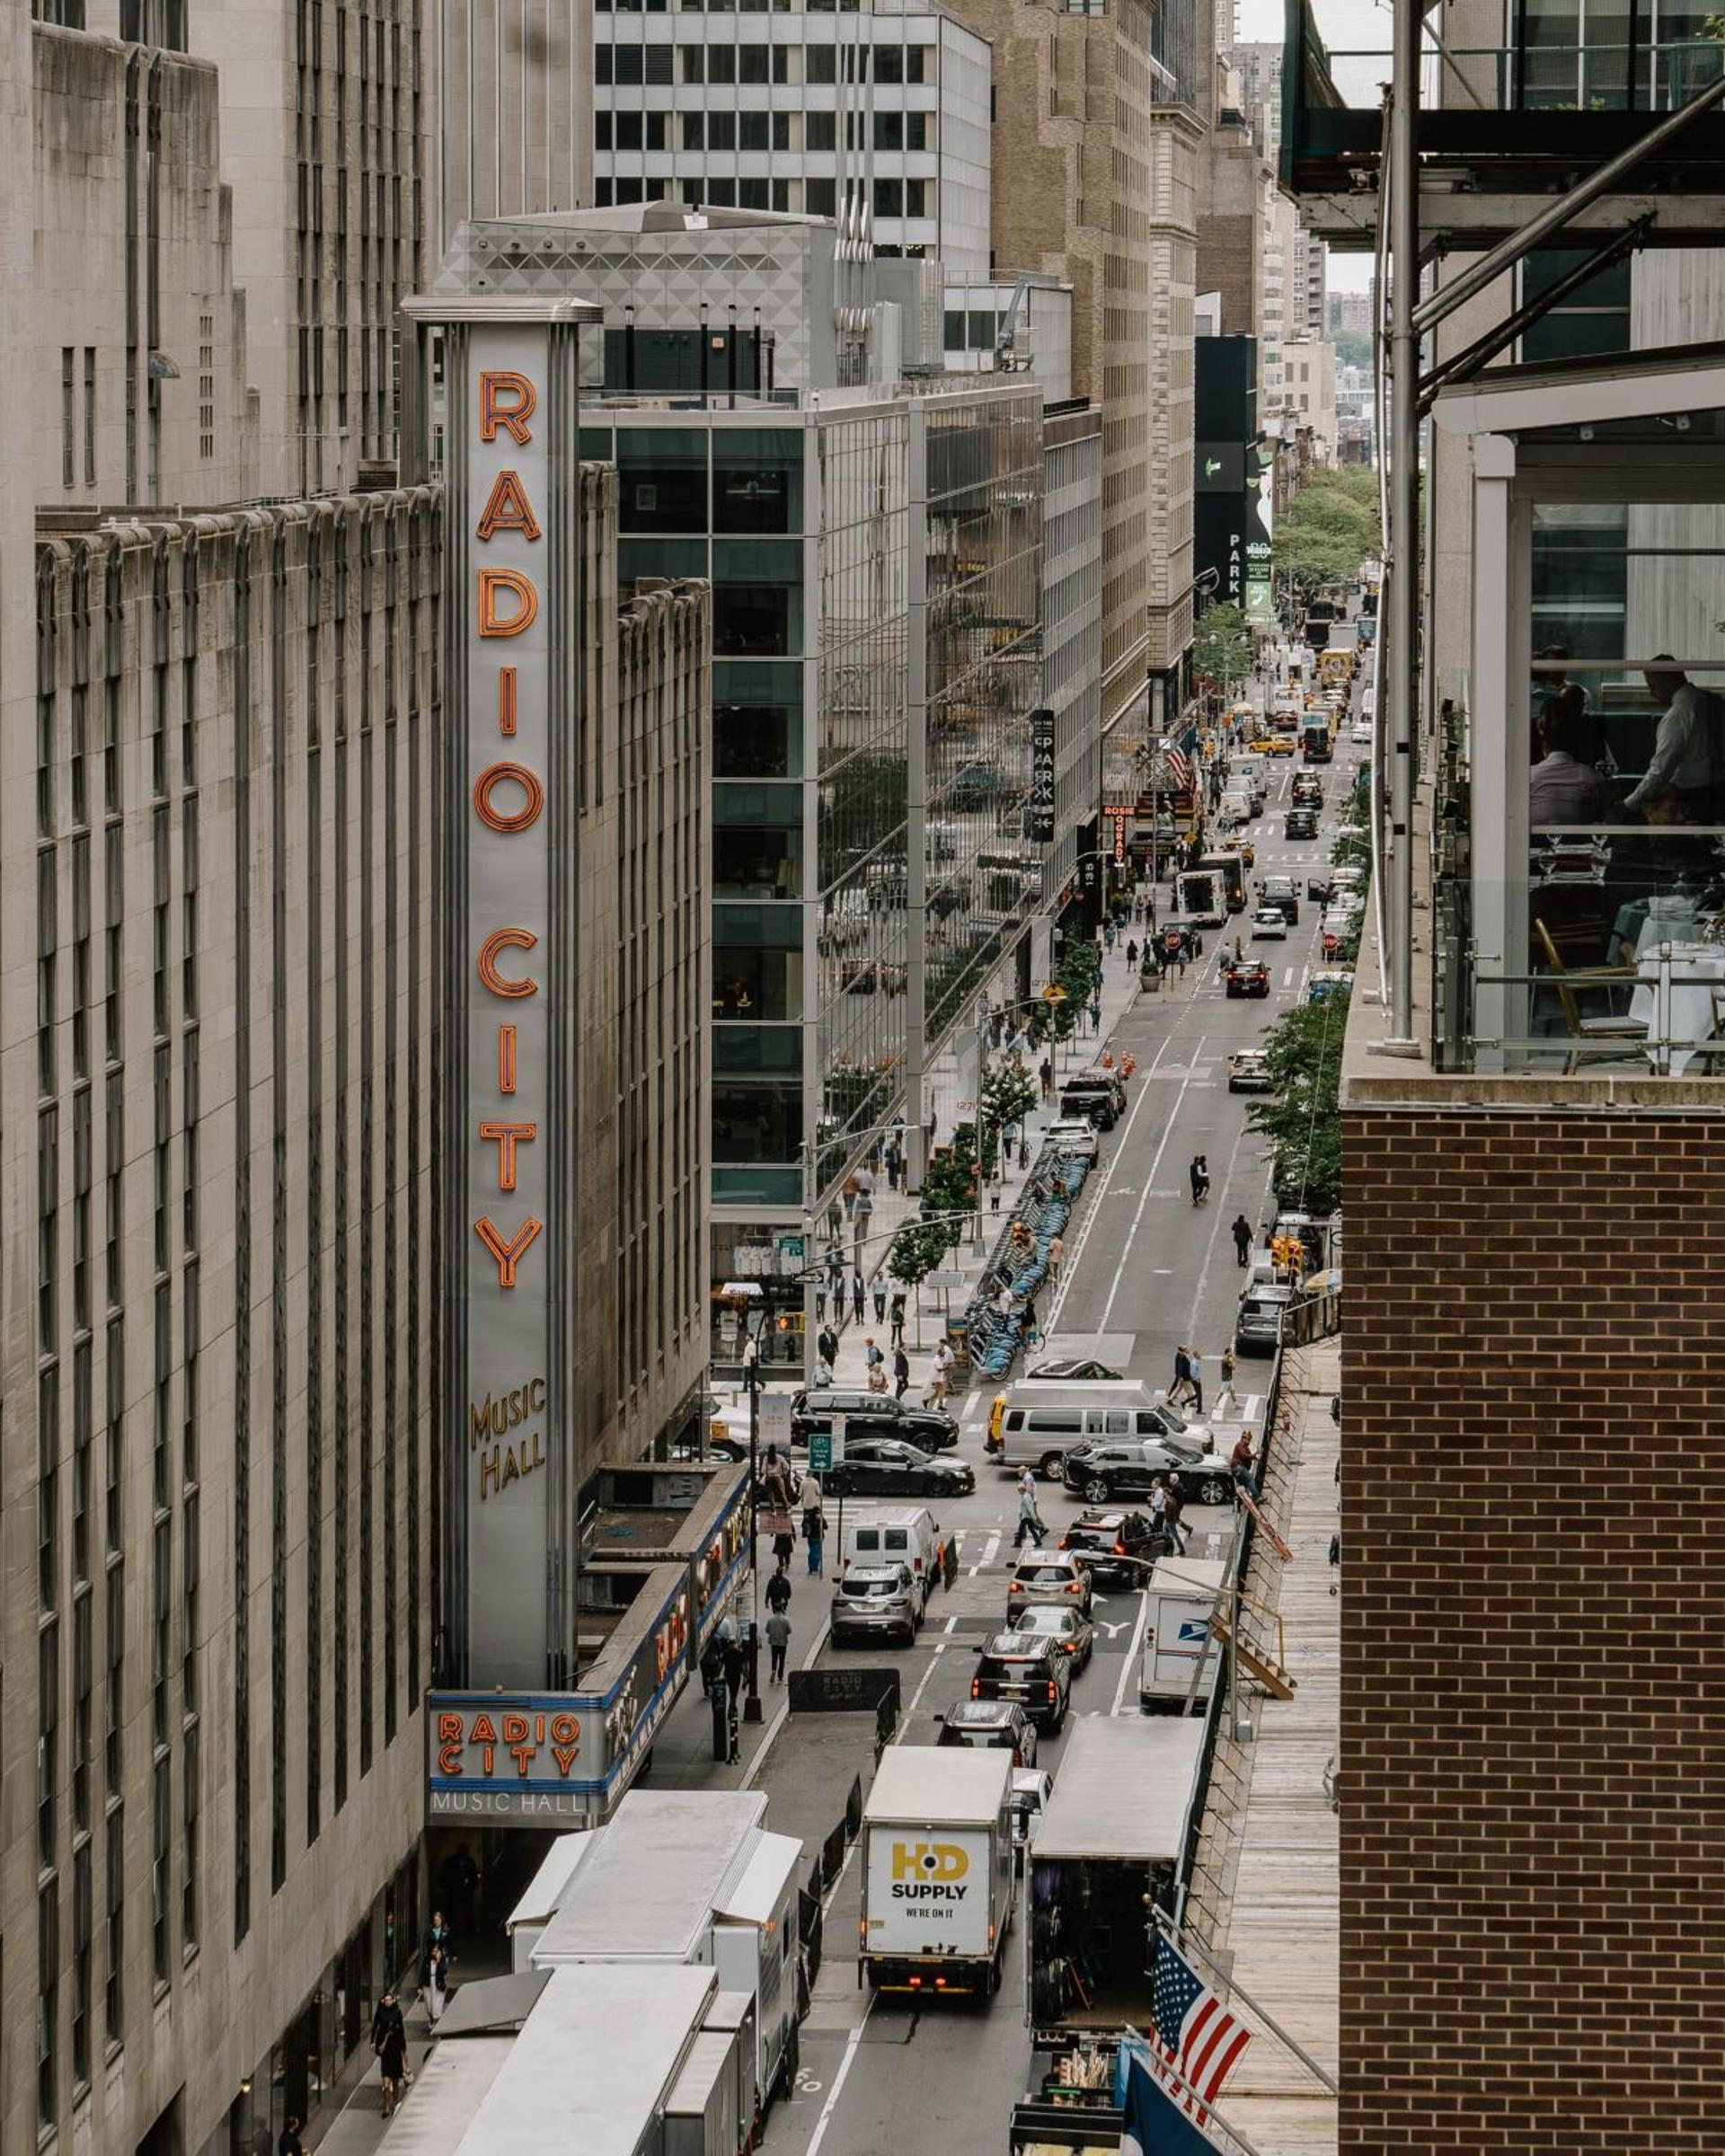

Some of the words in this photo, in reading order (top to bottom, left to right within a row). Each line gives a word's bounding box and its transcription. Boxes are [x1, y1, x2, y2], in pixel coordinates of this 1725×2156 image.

[1229, 535, 1240, 593] PARK
[473, 371, 544, 833] RADIO
[1042, 737, 1053, 800] PARK
[1085, 863, 1094, 885] 135
[474, 927, 543, 1287] CITY
[471, 1378, 545, 1452] MUSIC
[481, 1433, 545, 1500] HALL
[438, 1713, 581, 1745] RADIO
[438, 1745, 579, 1776] CITY
[432, 1792, 510, 1812] MUSIC
[520, 1793, 584, 1813] HALL
[892, 1842, 969, 1881] HD
[891, 1884, 968, 1900] SUPPLY
[932, 1908, 943, 1919] ON
[945, 1909, 954, 1920] IT
